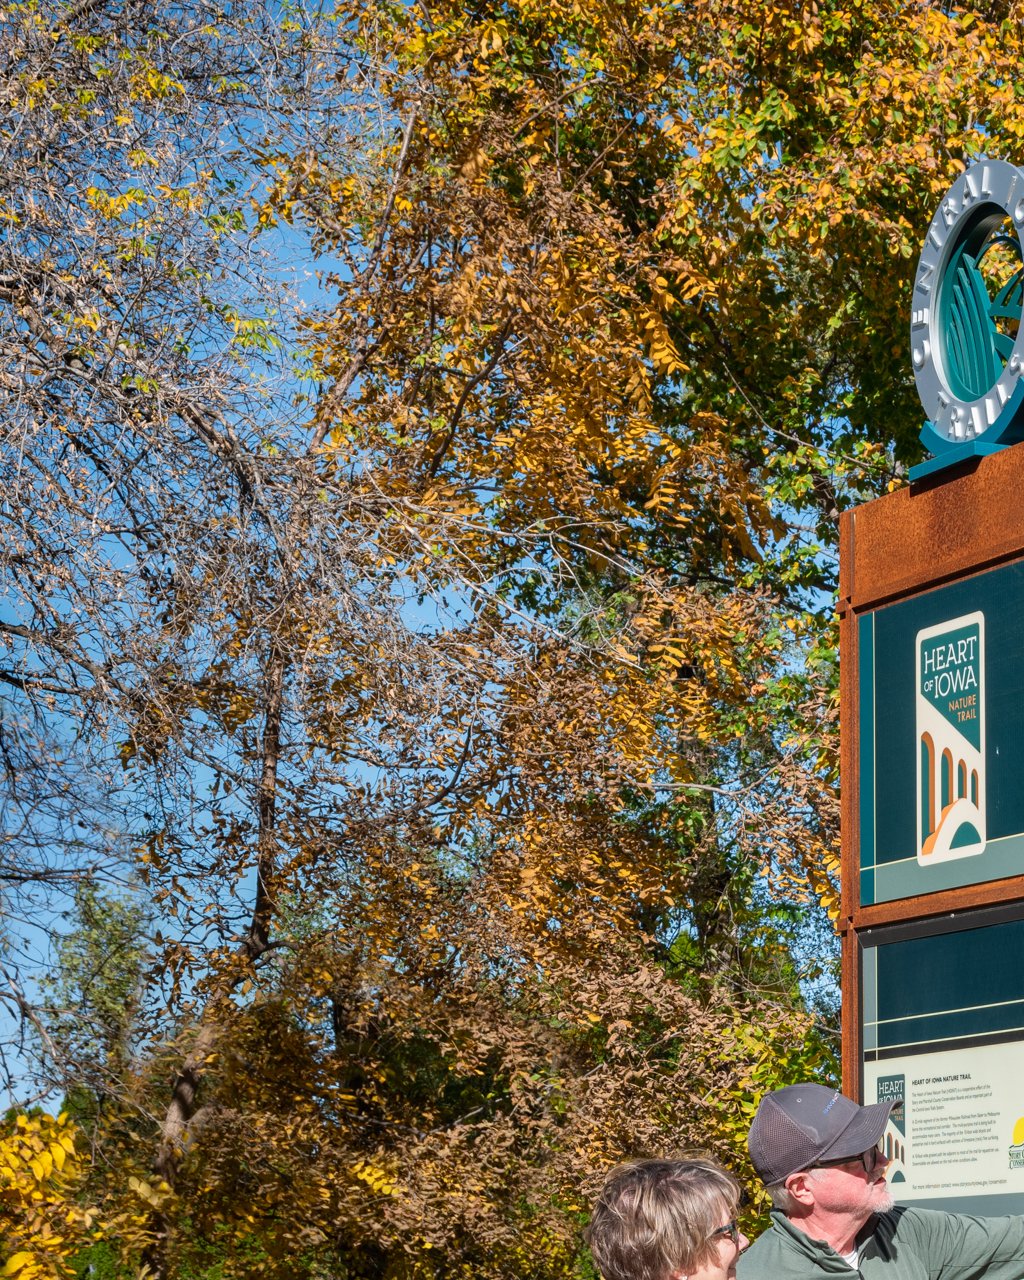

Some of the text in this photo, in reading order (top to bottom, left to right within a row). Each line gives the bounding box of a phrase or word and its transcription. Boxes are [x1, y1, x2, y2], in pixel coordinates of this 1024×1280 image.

[911, 165, 993, 372] CENTRAL
[923, 635, 977, 675] HEART
[923, 665, 978, 699] OF IOWA
[948, 694, 977, 712] NATURE
[957, 708, 977, 722] TRAIL
[878, 1080, 904, 1094] HEART
